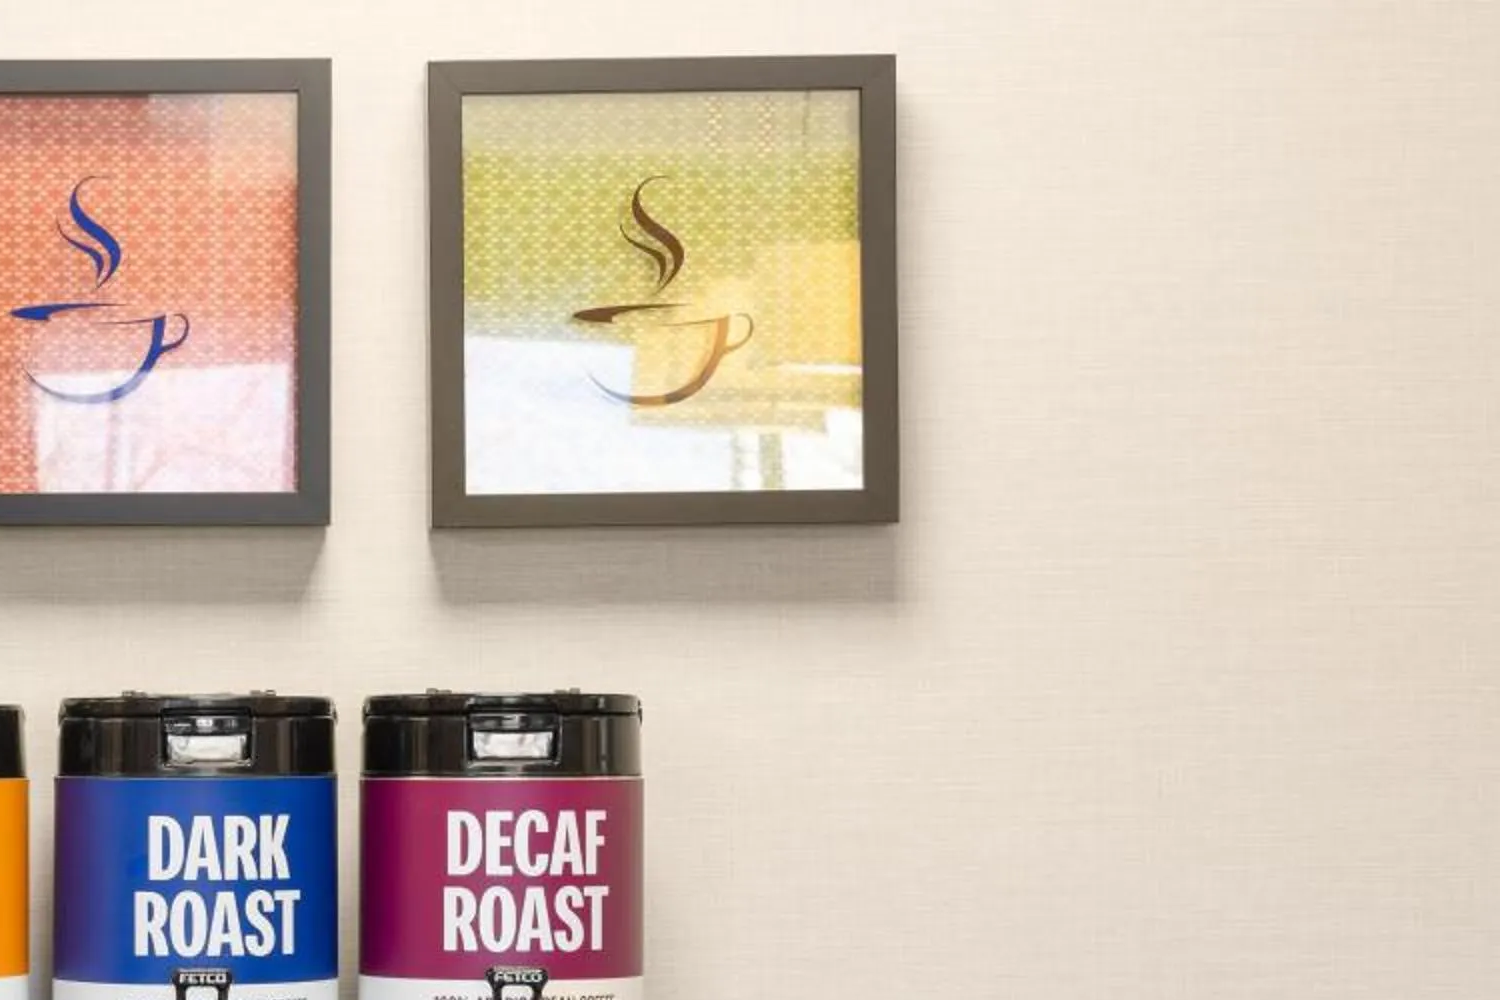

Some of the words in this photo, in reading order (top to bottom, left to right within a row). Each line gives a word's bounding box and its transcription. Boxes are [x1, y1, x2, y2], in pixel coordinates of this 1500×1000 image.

[148, 814, 290, 881] DARK
[447, 809, 607, 877] DECAF
[134, 889, 301, 958] ROAST
[443, 885, 609, 953] ROAST
[179, 973, 227, 984] FETCO
[493, 971, 543, 983] FETCO
